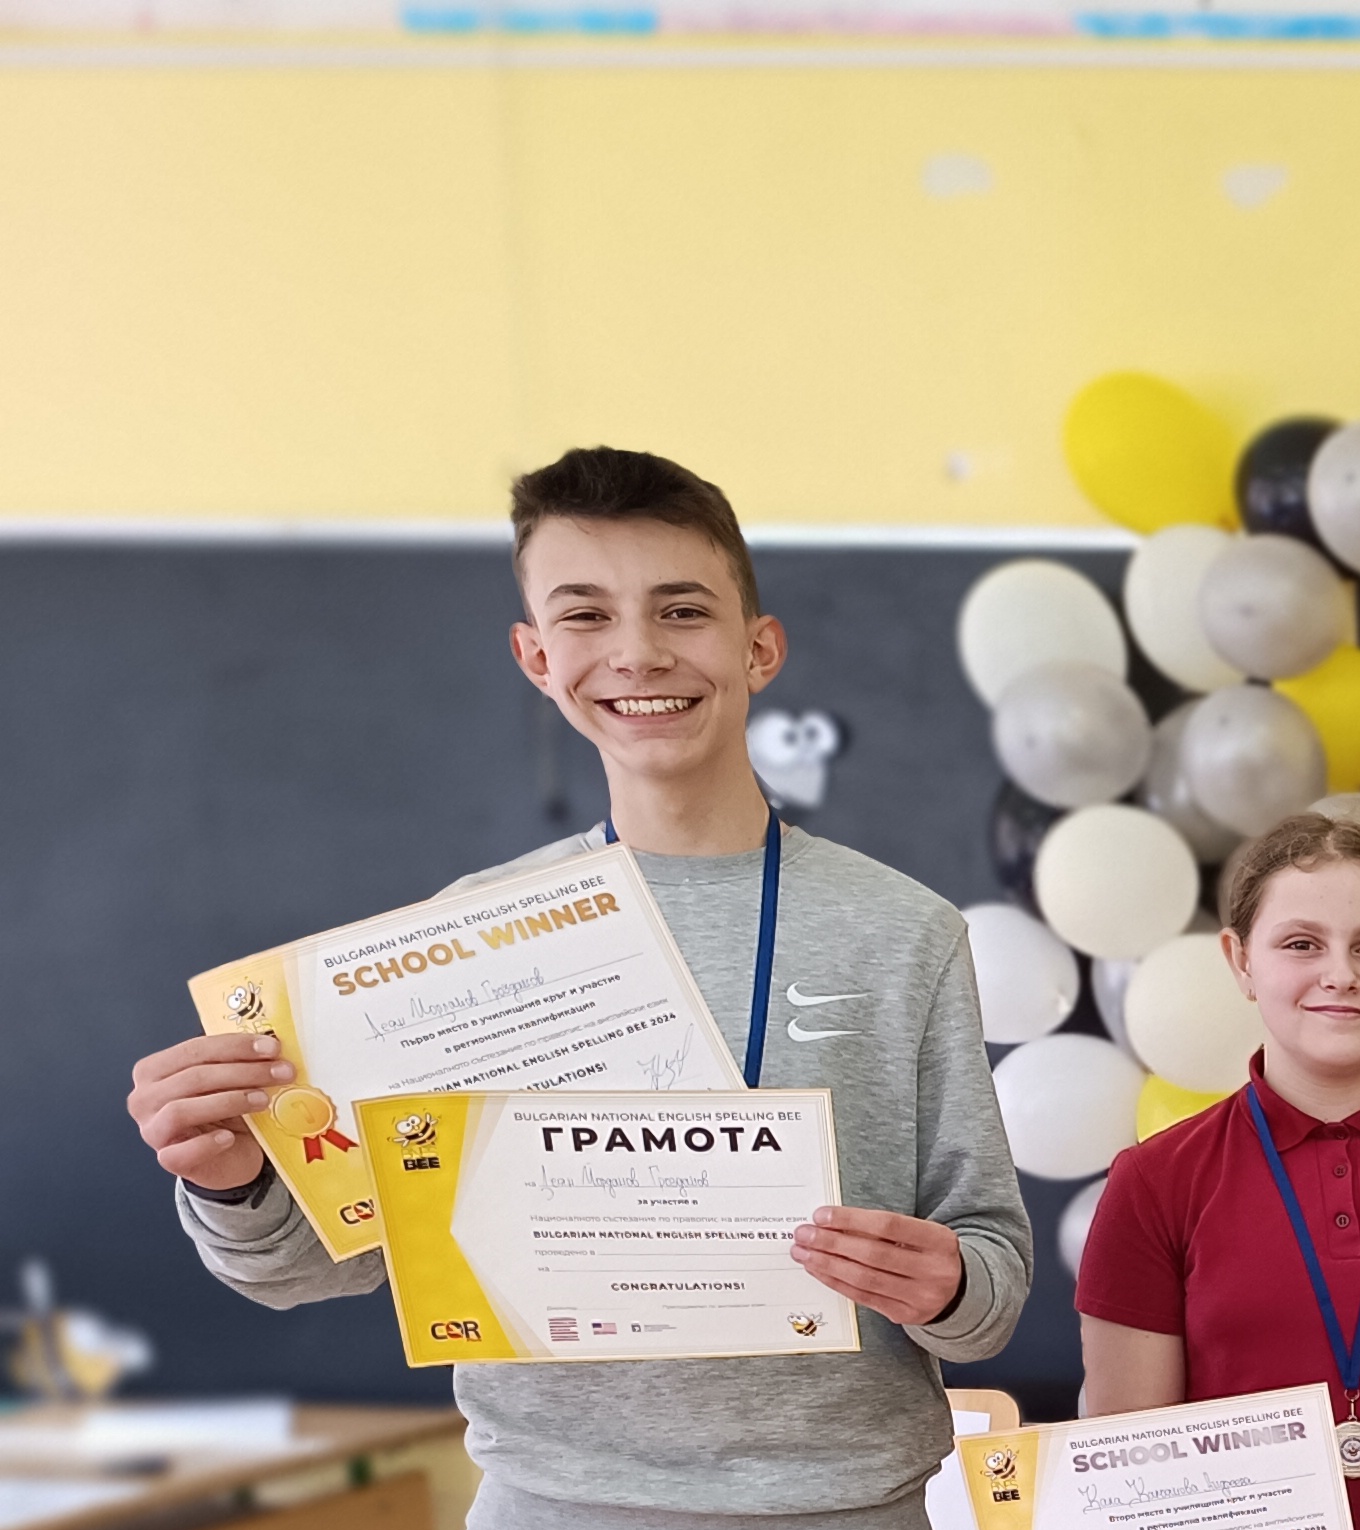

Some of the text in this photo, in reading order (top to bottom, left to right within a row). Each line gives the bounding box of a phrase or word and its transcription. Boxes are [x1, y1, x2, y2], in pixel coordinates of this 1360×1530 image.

[323, 875, 605, 967] BULGARIAN NATIONAL ENGLISH SPELLING BEE
[332, 892, 620, 995] SCHOOL WINNER
[399, 1033, 435, 1048] Първо
[436, 1022, 468, 1036] място
[478, 998, 541, 1025] училищния
[542, 990, 566, 1003] кръг
[578, 974, 620, 994] участие
[452, 1027, 516, 1052] регионална
[517, 1001, 595, 1030] квалификация
[463, 1012, 676, 1085] NATIONAL ENGLISH SPELLING BEE 2024
[519, 1062, 608, 1091] TULATIONS!
[513, 1111, 801, 1121] BULGARIAN NATIONAL ENGLISH SPELLING BEE
[541, 1126, 781, 1152] ГРАМОТА
[402, 1156, 440, 1170] BEE
[533, 1230, 595, 1238] BULGARIAN
[598, 1230, 653, 1239] NATIONAL
[656, 1231, 701, 1239] ENGLISH
[704, 1231, 754, 1239] SPELLING
[610, 1282, 744, 1291] CONGRATULATIONS!
[1069, 1407, 1302, 1449] BULGARIAN NATIONAL ENGLISH SPELLING BEE
[1073, 1421, 1307, 1473] SCHOOL WINNER
[992, 1490, 1020, 1502] BEE
